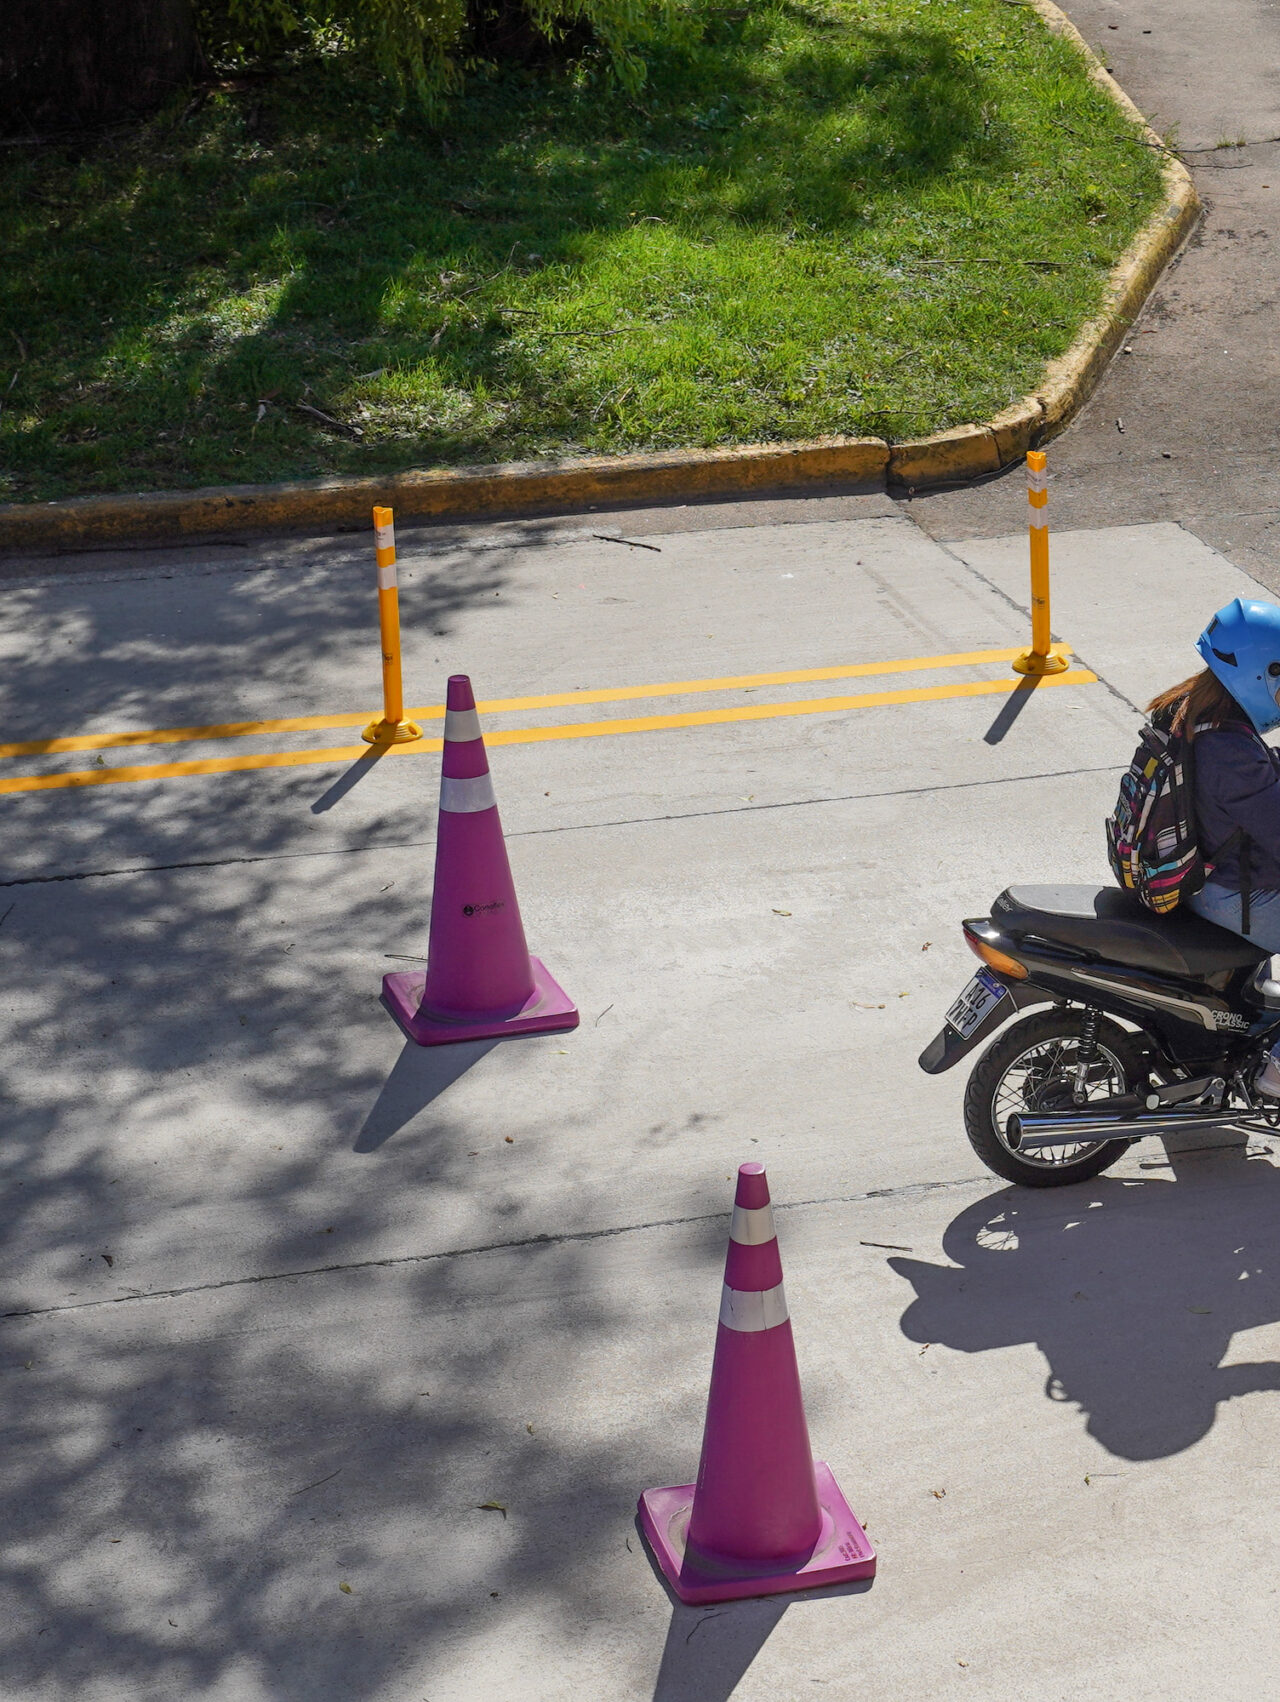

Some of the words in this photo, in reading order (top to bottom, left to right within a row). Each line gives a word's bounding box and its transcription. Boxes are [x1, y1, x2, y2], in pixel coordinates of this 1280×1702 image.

[965, 982, 991, 1010] A16
[1211, 1010, 1243, 1021] CRONO
[1214, 1016, 1250, 1029] CLASSIC
